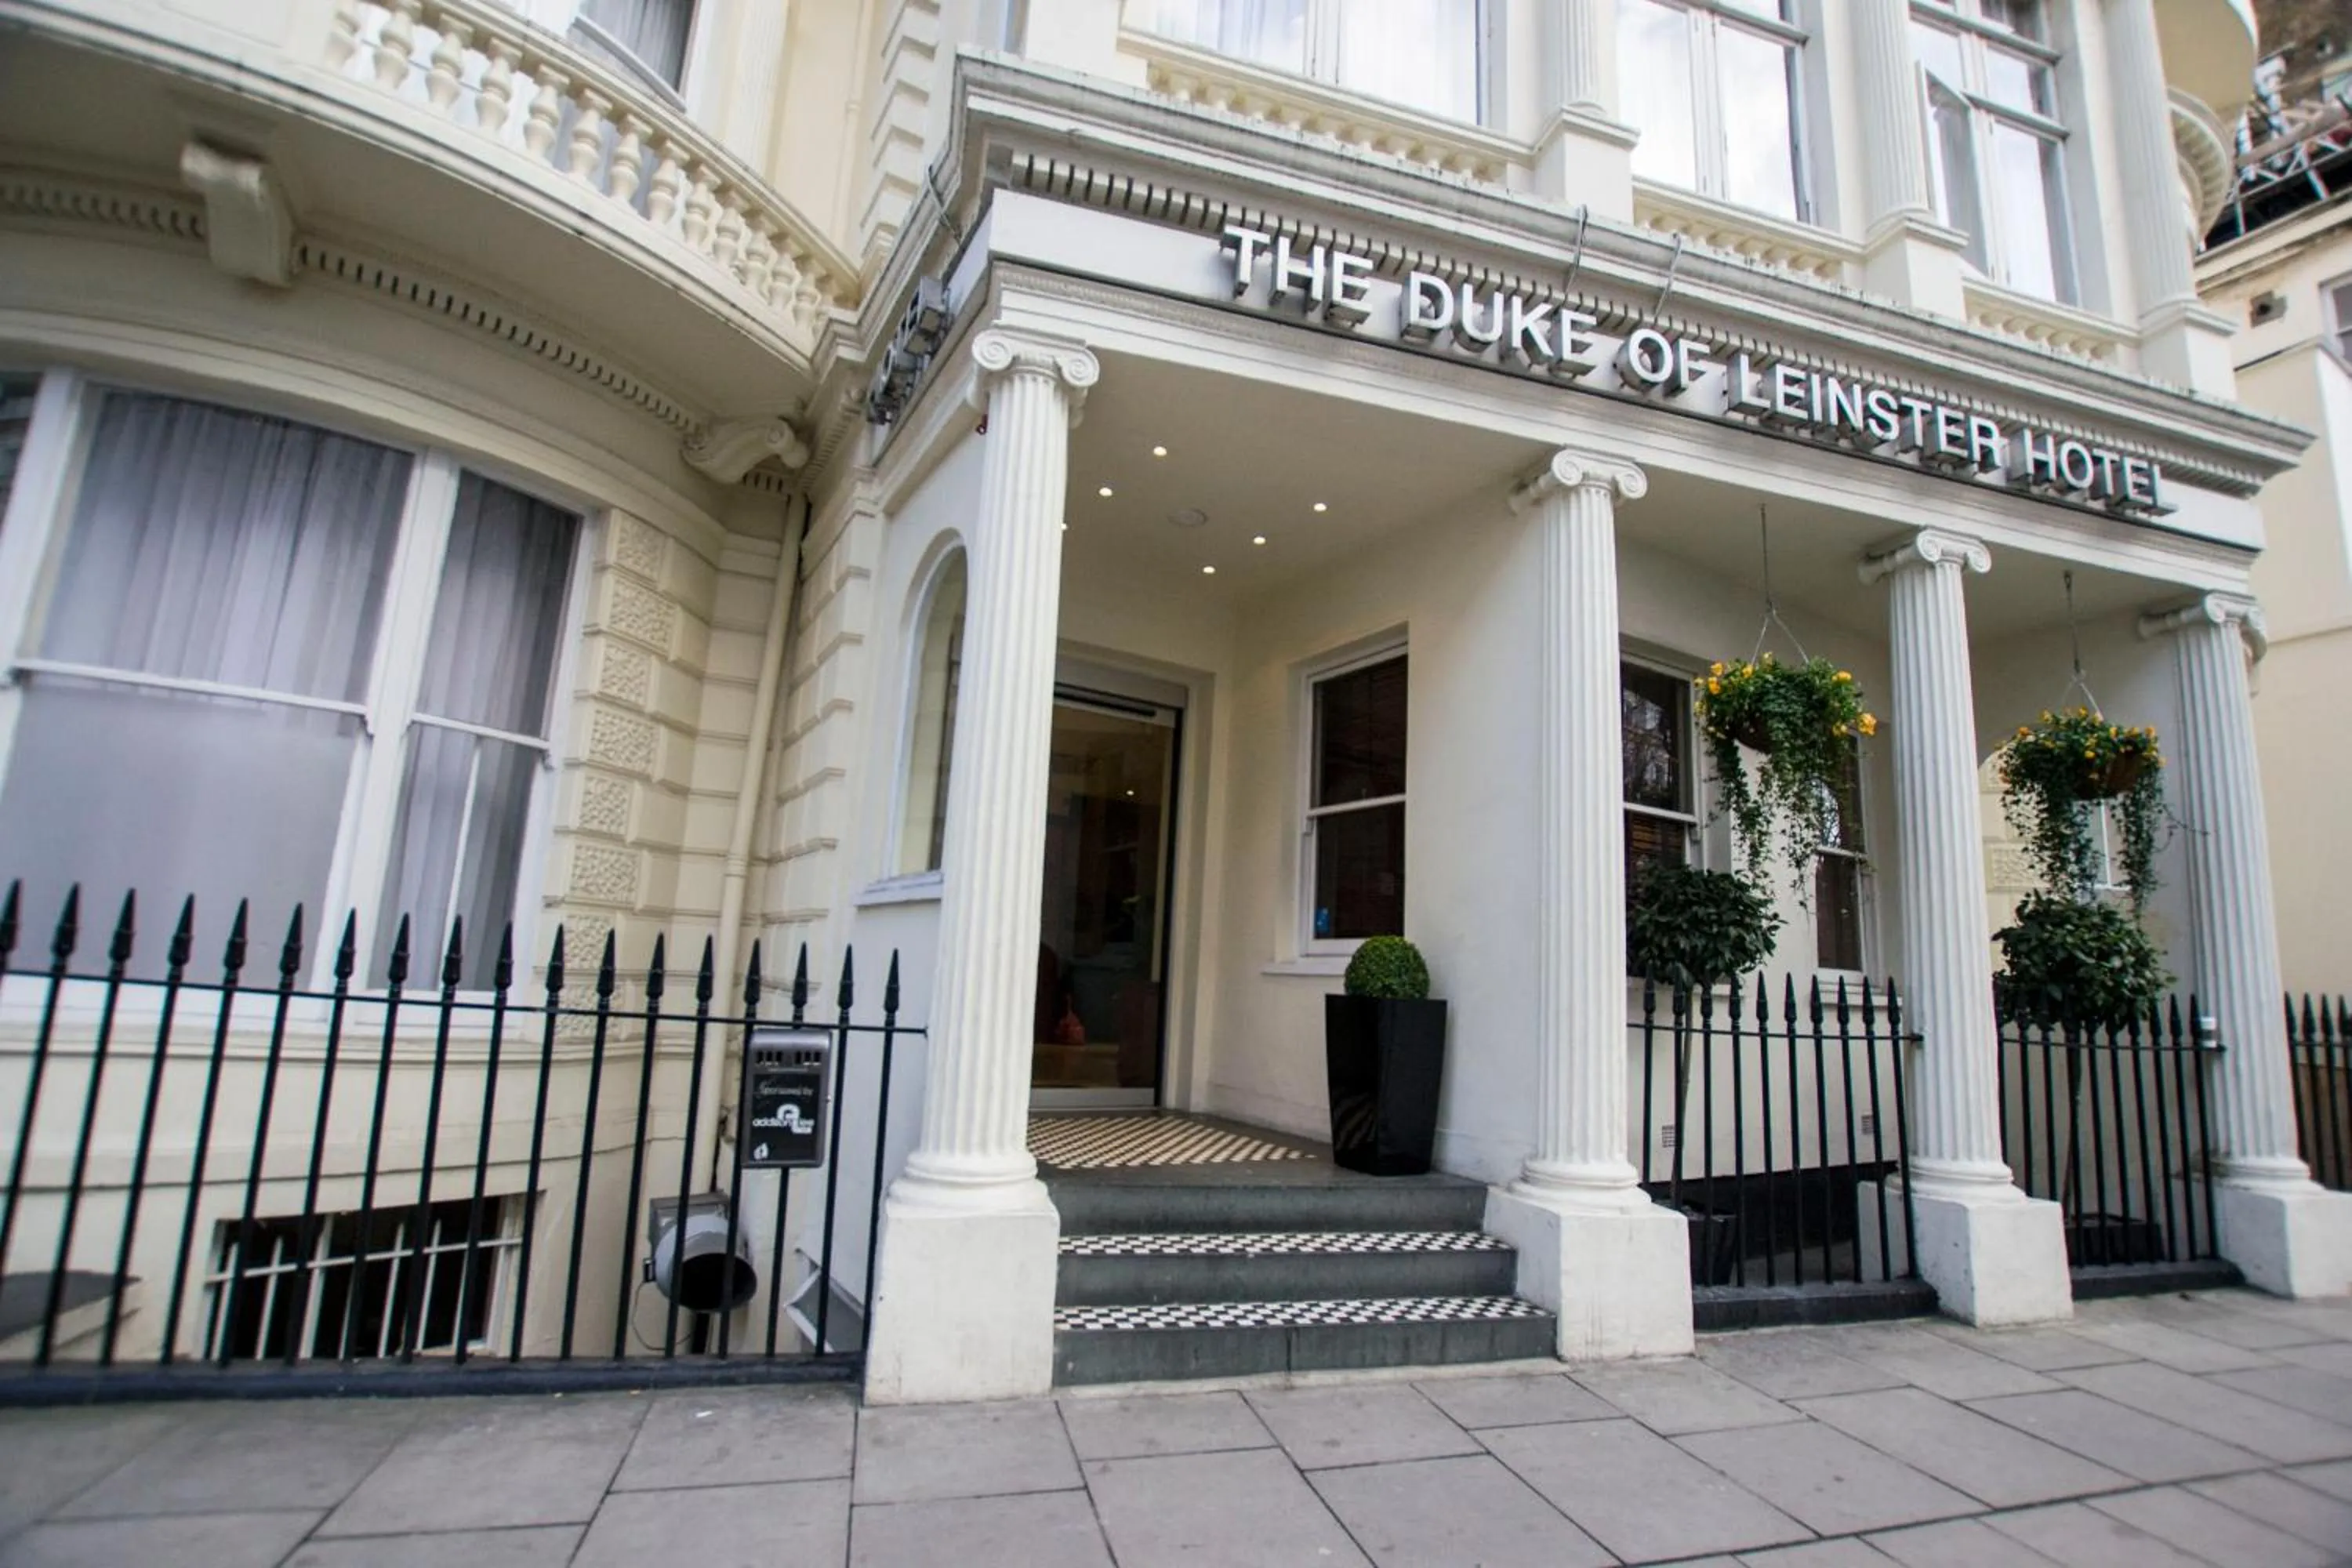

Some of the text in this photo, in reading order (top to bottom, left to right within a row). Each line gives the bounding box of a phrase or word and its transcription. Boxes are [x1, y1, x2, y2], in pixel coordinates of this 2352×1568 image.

[1223, 224, 2177, 514] THE DUKE OF LEINSTER HOTEL
